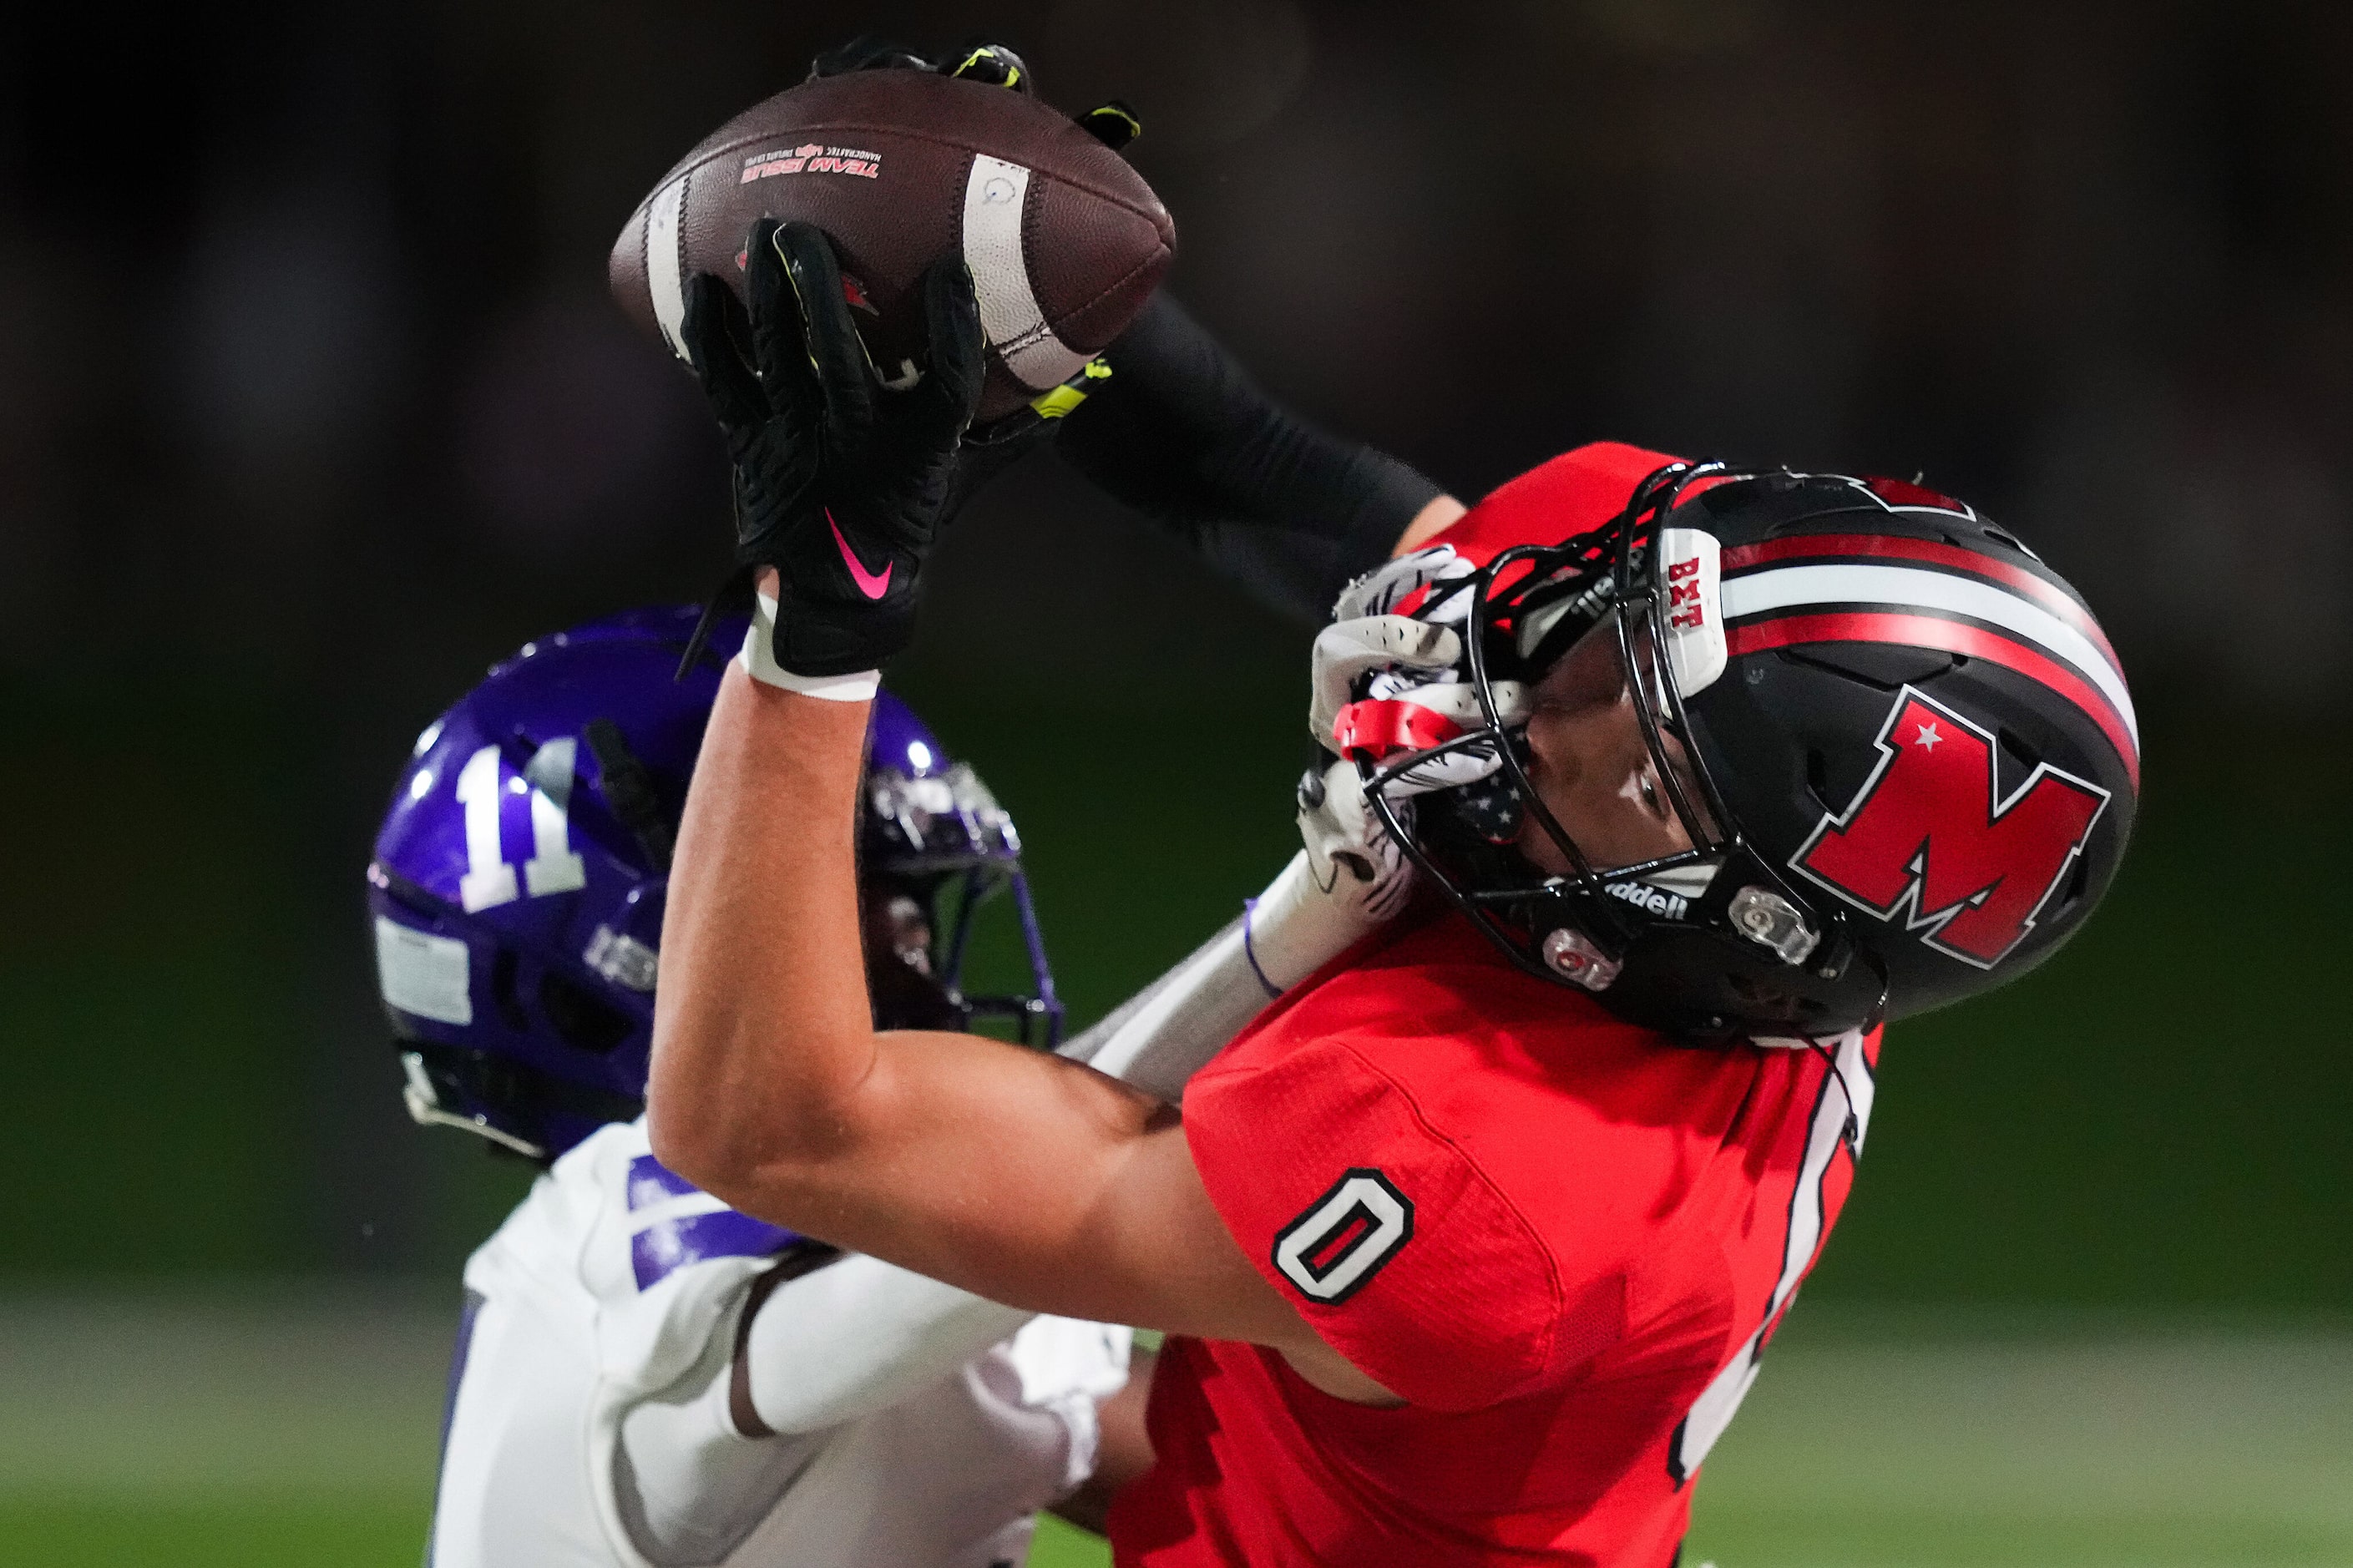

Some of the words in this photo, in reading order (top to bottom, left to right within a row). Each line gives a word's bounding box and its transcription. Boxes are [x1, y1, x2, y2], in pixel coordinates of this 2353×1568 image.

[741, 157, 807, 184] ISSUE
[807, 157, 879, 179] TEAM
[455, 736, 587, 914] 11
[1788, 684, 2111, 970] M
[1604, 881, 1688, 921] ddell
[1271, 1166, 1414, 1306] 0
